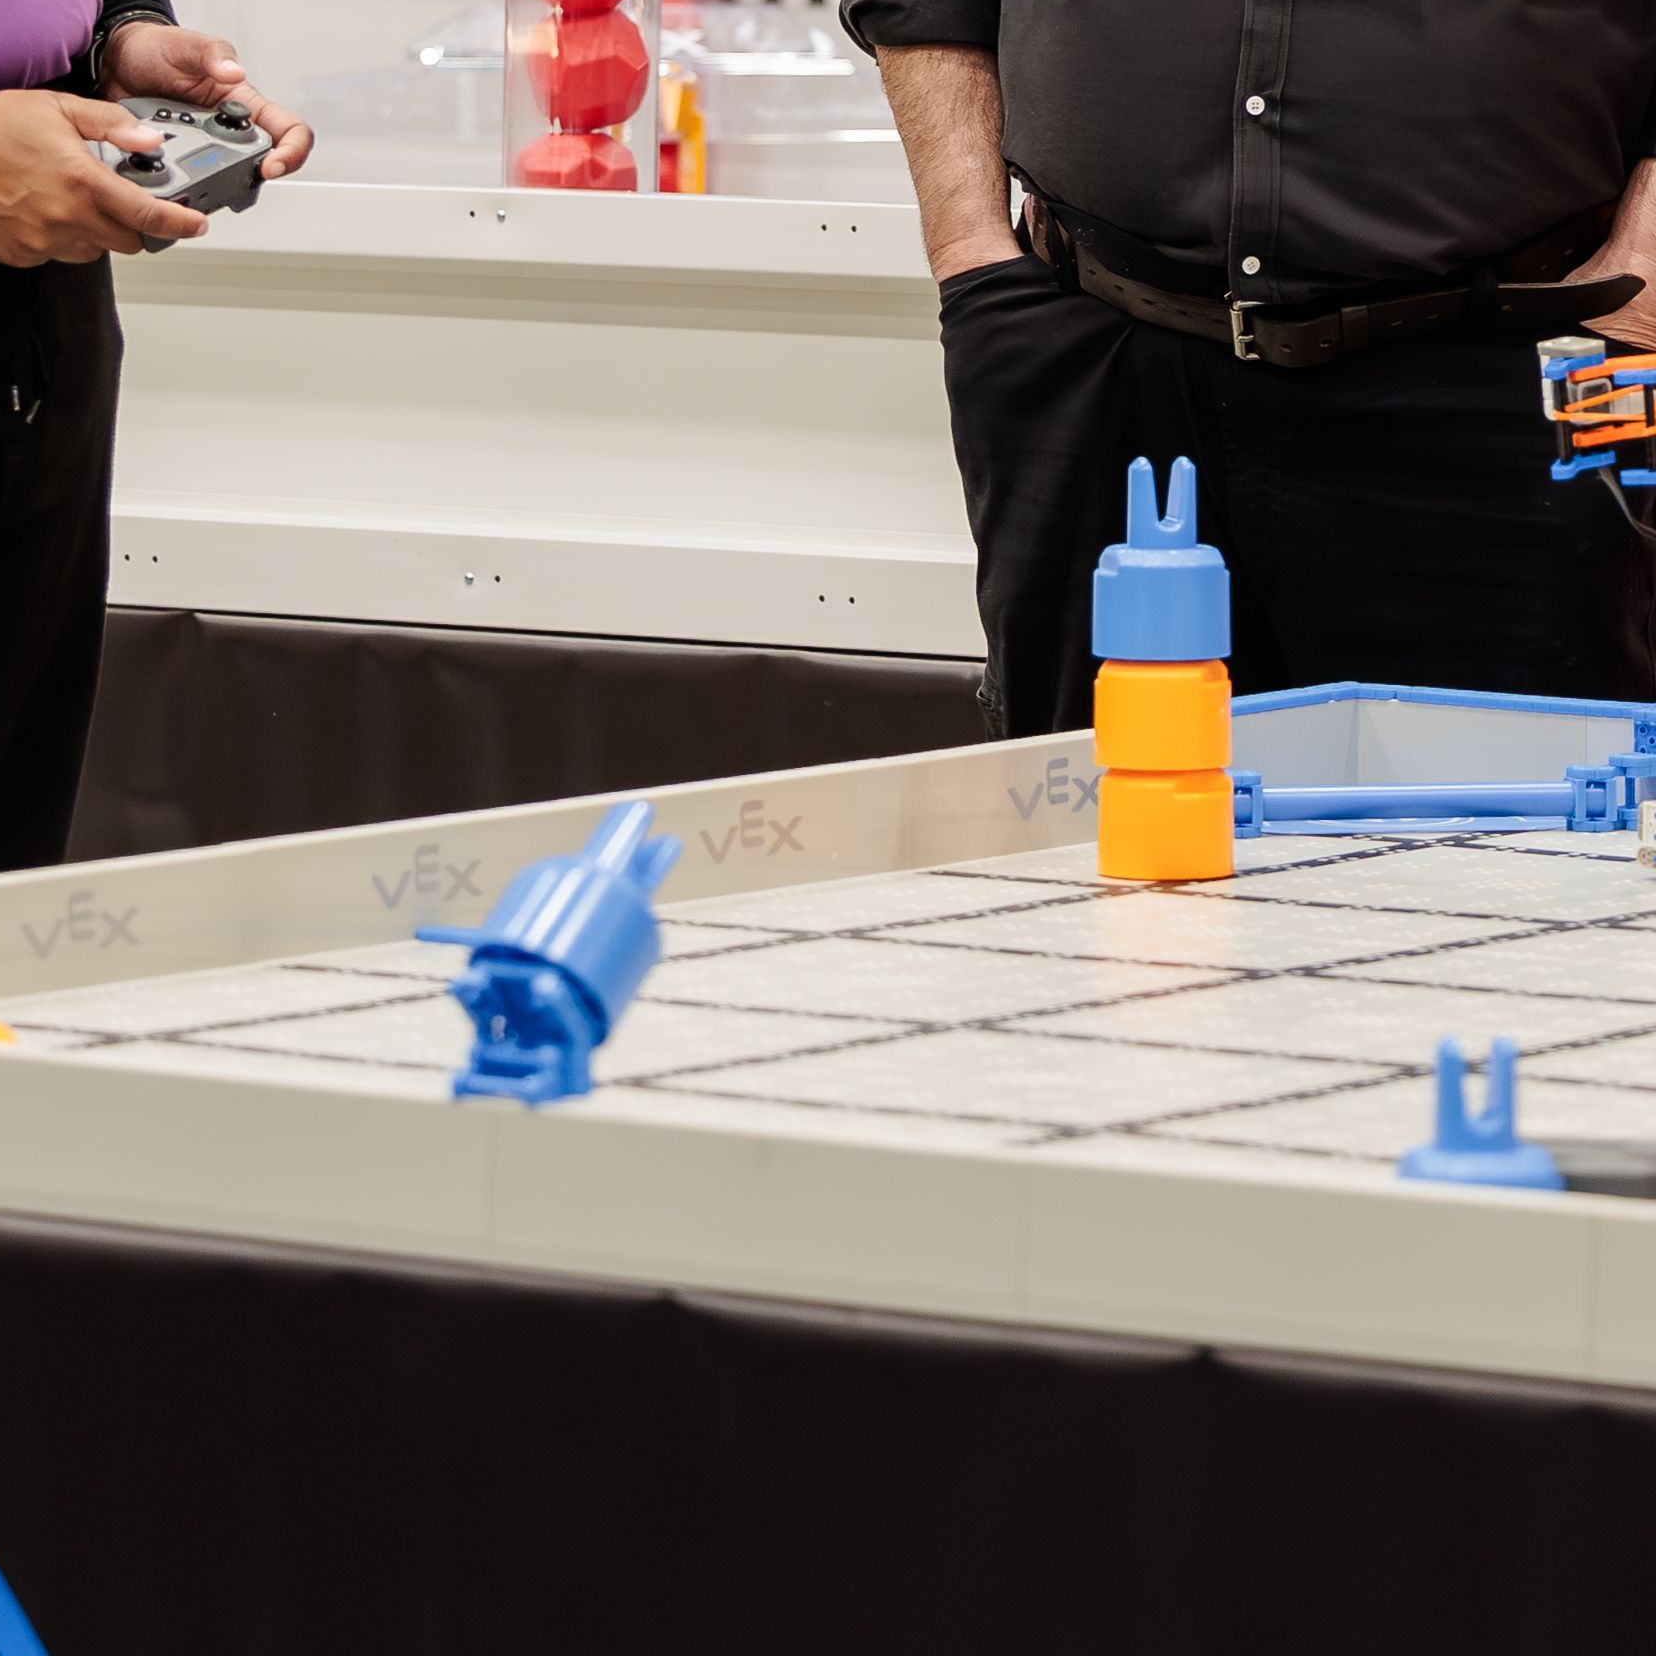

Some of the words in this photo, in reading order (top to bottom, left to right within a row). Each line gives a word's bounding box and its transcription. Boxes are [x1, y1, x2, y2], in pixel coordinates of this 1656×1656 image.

[1008, 757, 1099, 822] VEX
[699, 800, 805, 864] VEX
[371, 844, 483, 909] VEX
[21, 891, 140, 959] VEX
